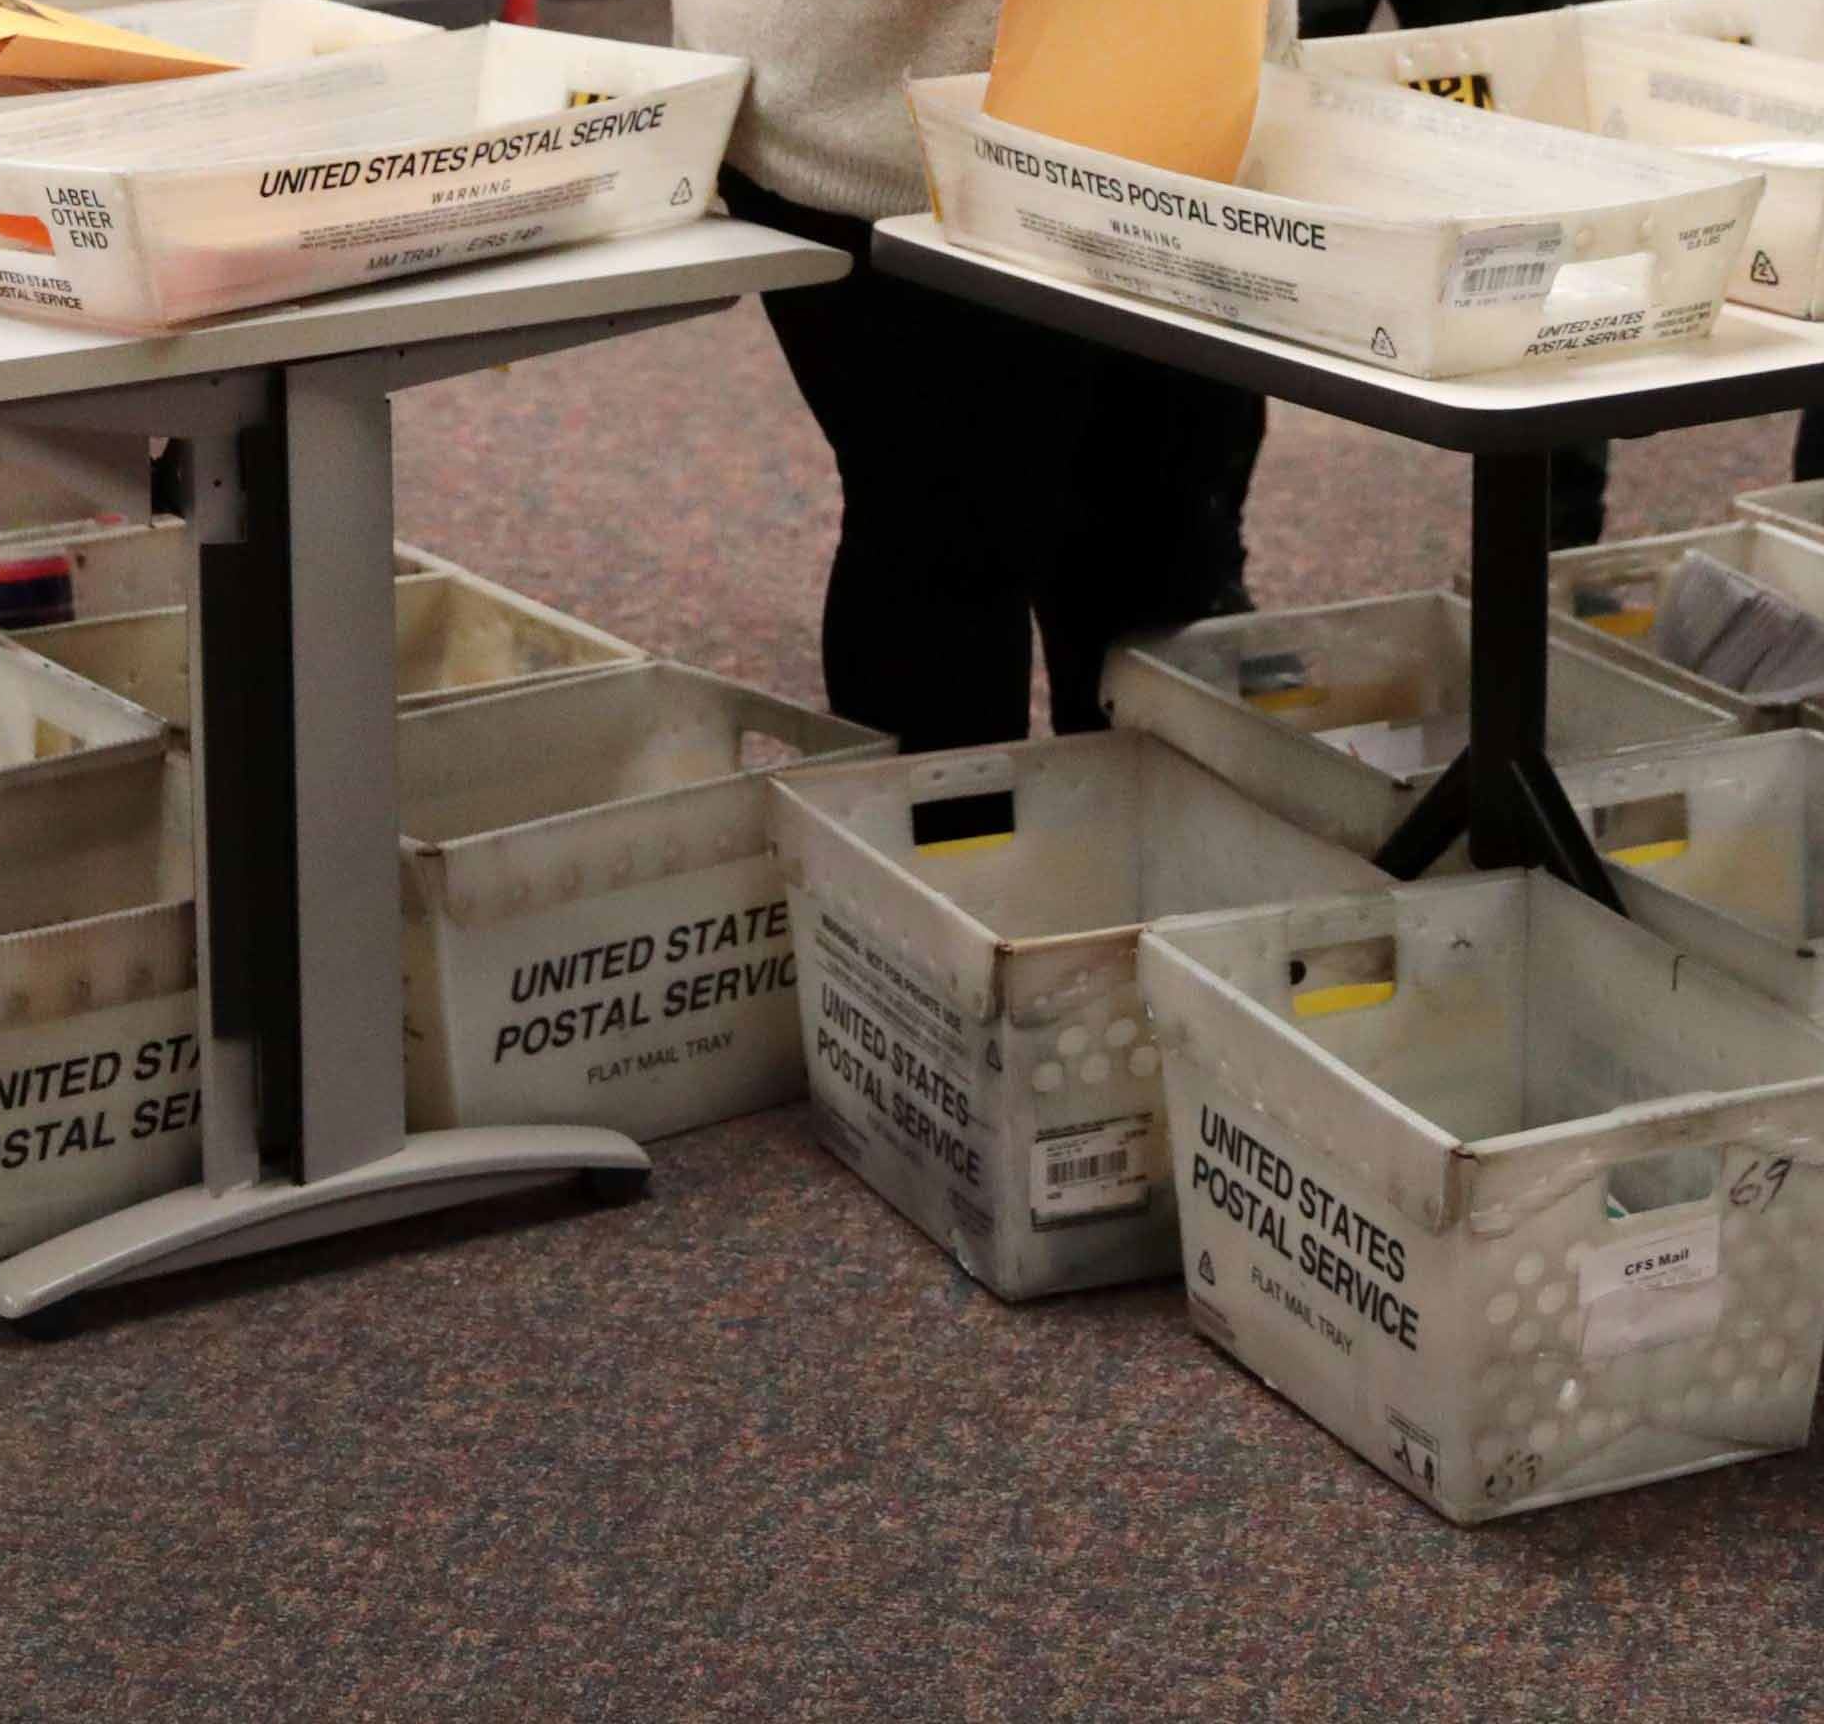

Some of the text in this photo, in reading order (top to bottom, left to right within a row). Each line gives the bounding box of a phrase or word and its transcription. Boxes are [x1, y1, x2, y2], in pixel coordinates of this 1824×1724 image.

[259, 102, 668, 199] UNITED STATES POSTAL SERVICE
[46, 186, 106, 208] LABEL
[51, 207, 115, 230] OTHER
[432, 178, 512, 205] WARNING
[973, 135, 1327, 252] UNITED STATES POSTAL SERVICE
[70, 228, 109, 250] END
[1110, 218, 1183, 251] WARNING
[26, 274, 73, 294] STATES
[33, 290, 84, 310] SERVICE
[1523, 326, 1644, 357] POSTAL SERVICE
[1537, 319, 1588, 340] UNITED
[1590, 310, 1646, 331] STATES
[510, 899, 788, 1004] UNITED STATE
[493, 990, 651, 1065] POSTAL
[662, 950, 799, 1018] SERVIC
[587, 1029, 736, 1085] FLAT MAIL TRAY
[822, 981, 970, 1128] UNITED STATES
[817, 1026, 889, 1116] POSTAL
[891, 1091, 982, 1189] SERVICE
[1200, 1103, 1294, 1202] UNITED
[1297, 1177, 1406, 1284] STATES
[1728, 1155, 1793, 1215] 69
[1192, 1152, 1294, 1261] POSTAL
[1298, 1232, 1420, 1352] SERVICE
[1623, 1246, 1690, 1278] CFS Mail
[1250, 1265, 1354, 1358] FLAT MAIL TRAY
